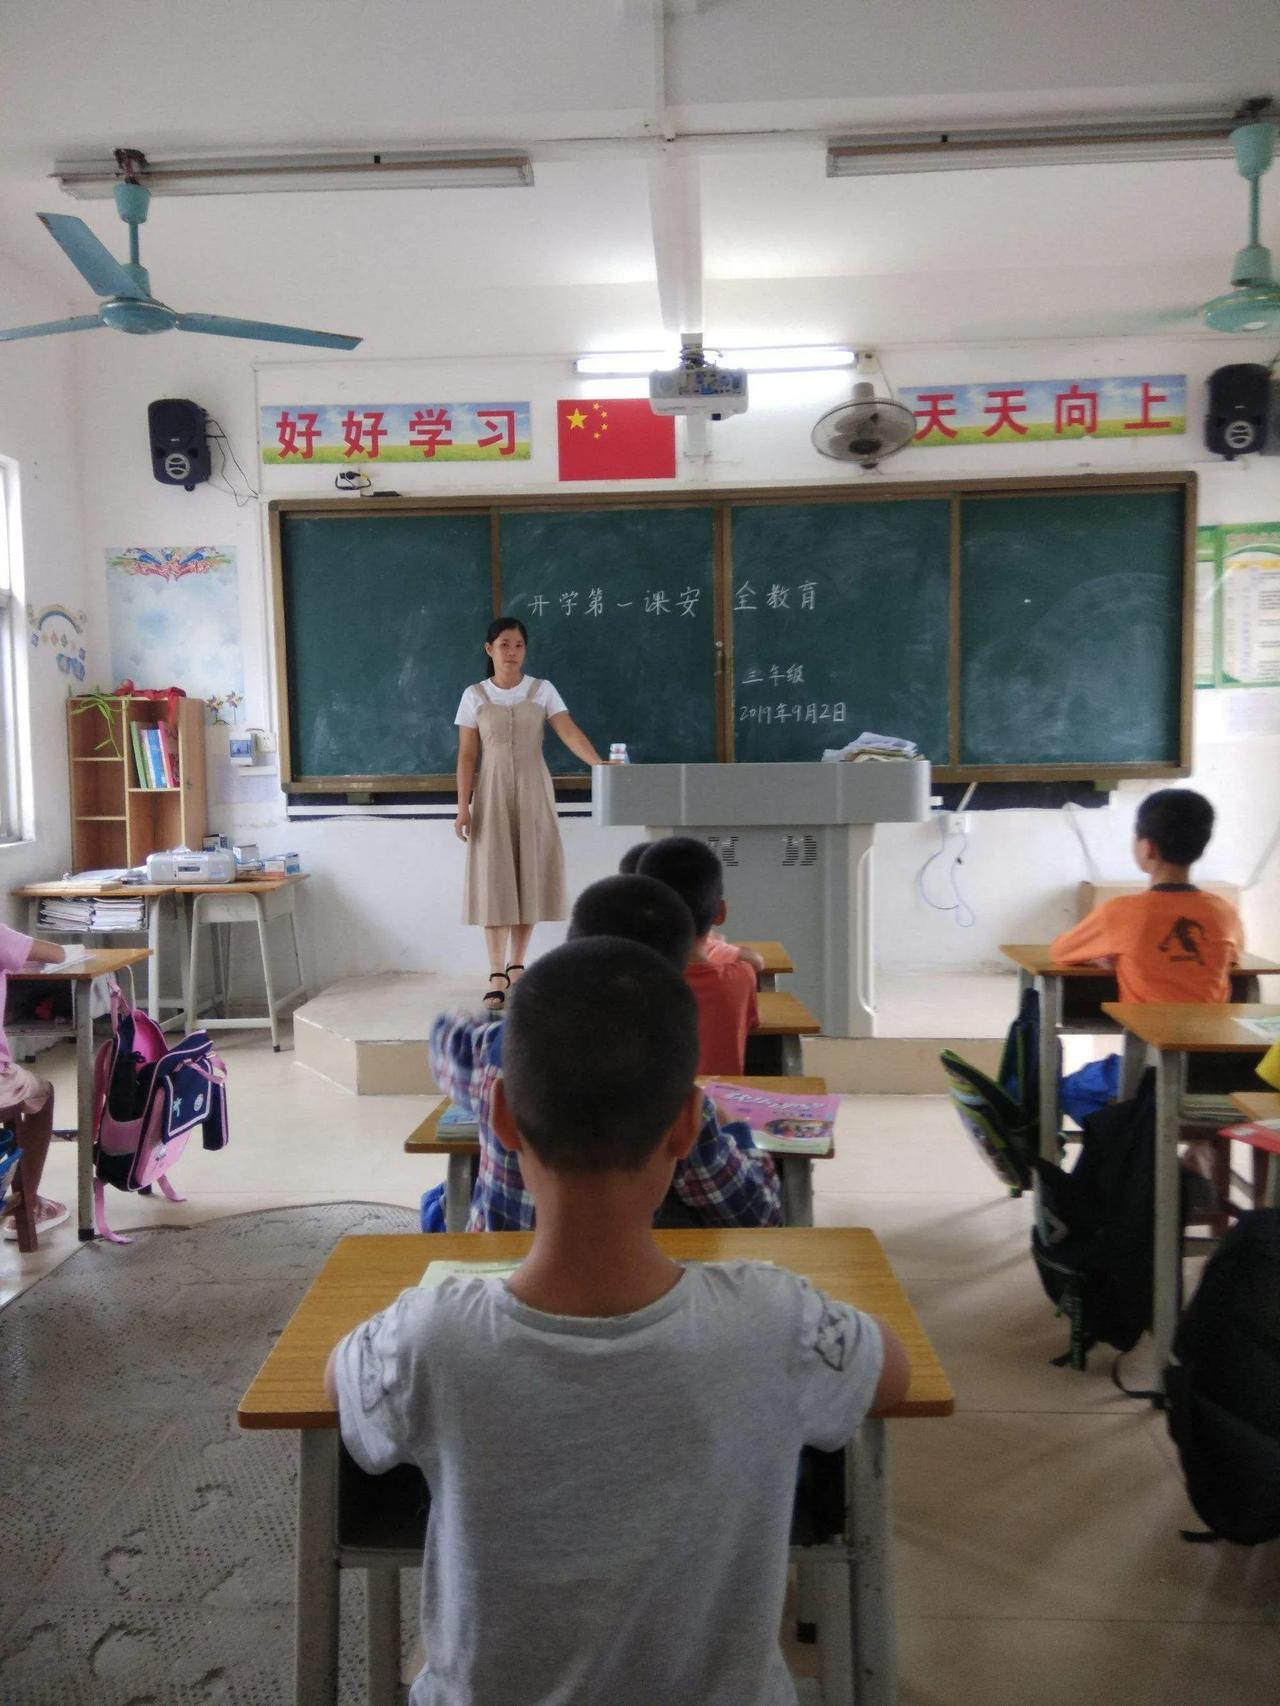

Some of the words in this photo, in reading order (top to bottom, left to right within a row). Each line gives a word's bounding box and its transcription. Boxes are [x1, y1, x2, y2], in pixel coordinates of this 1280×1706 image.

[913, 382, 1172, 441] 天天向上
[276, 408, 516, 460] 好好学习
[741, 664, 805, 687] 三年级
[739, 702, 846, 724] 2019年9月2日
